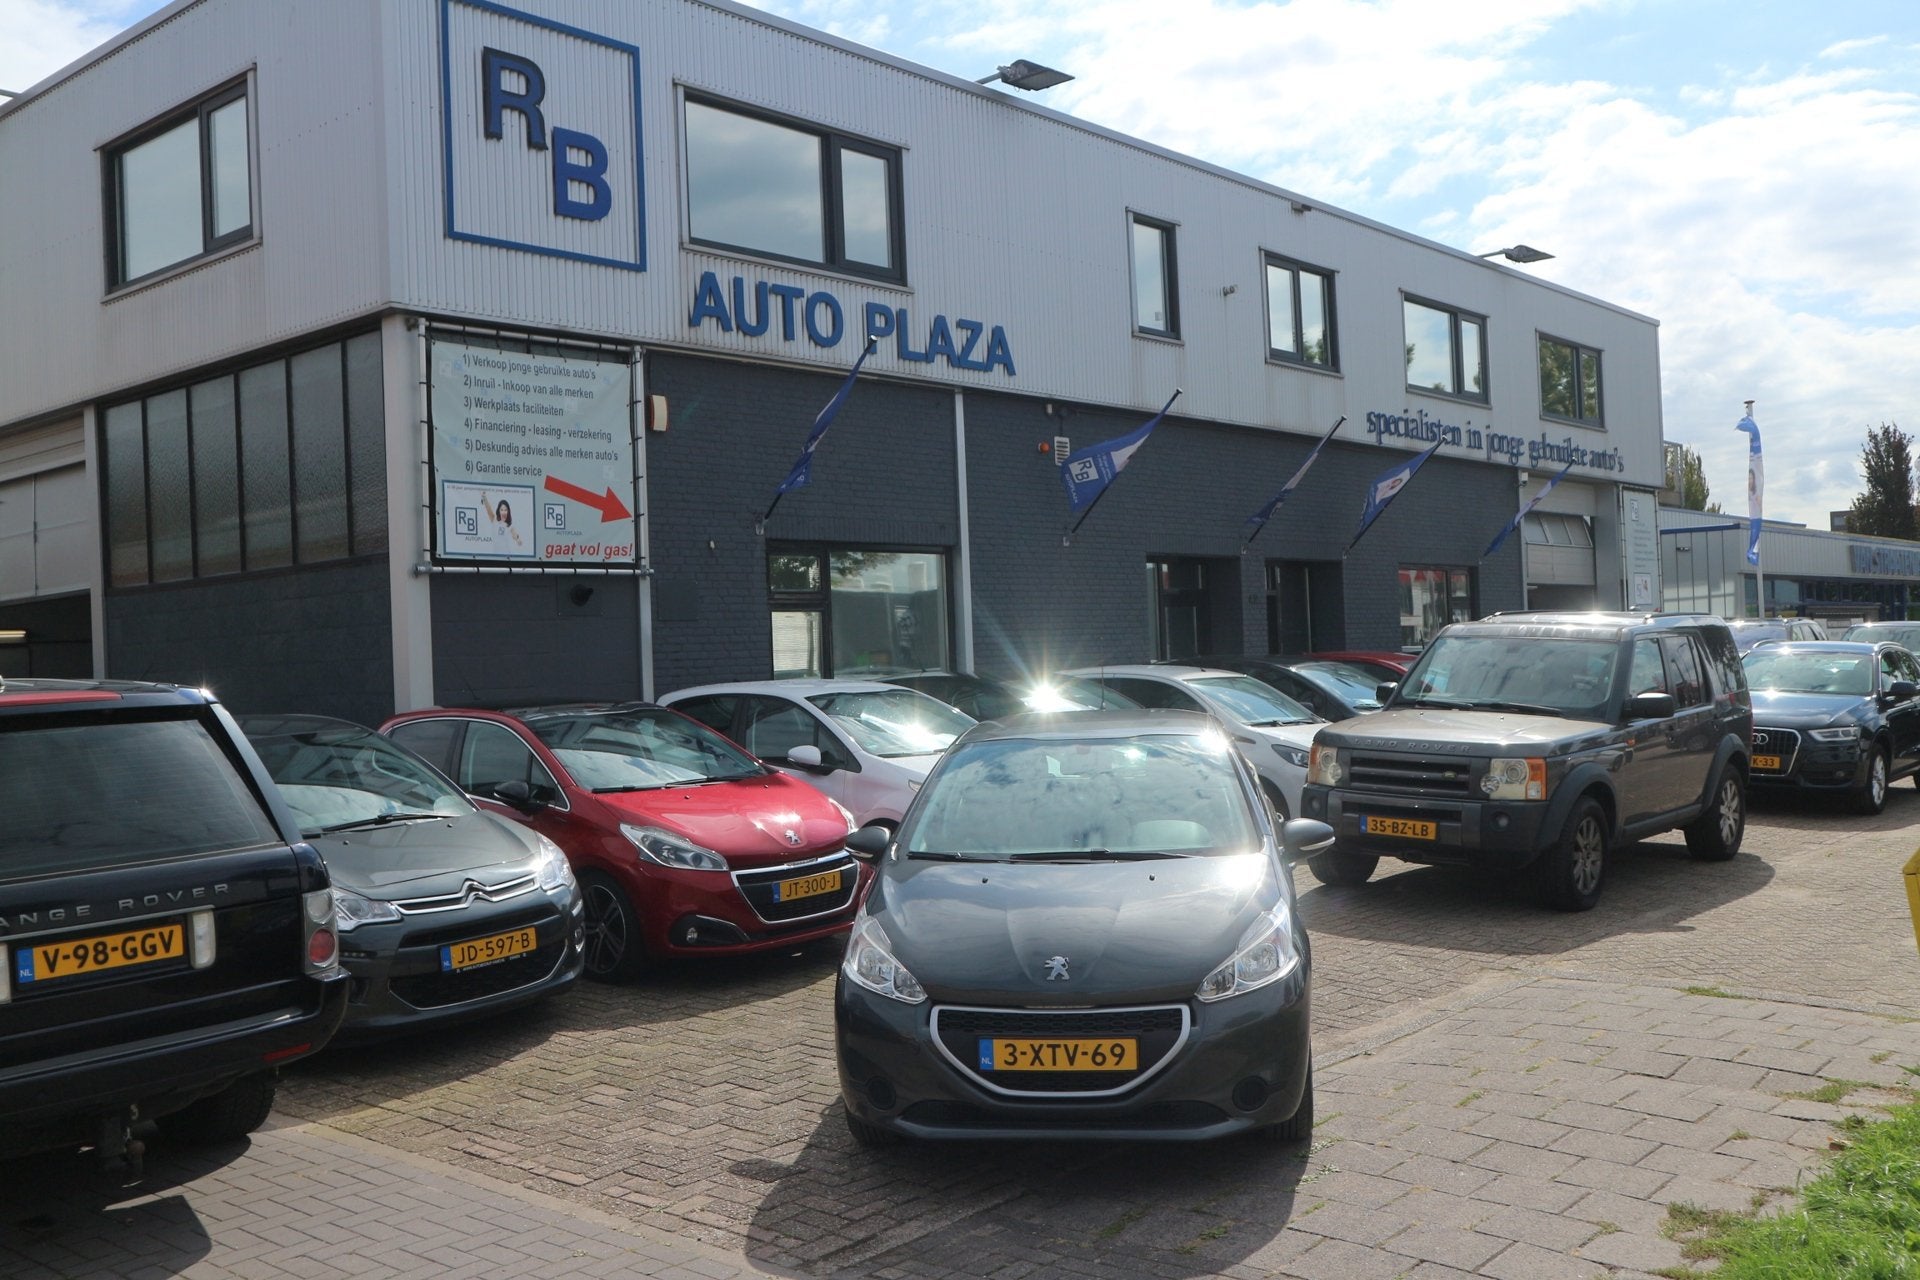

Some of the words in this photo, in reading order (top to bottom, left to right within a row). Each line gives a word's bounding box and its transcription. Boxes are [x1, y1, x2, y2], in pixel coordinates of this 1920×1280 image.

[482, 46, 612, 222] RB
[689, 271, 844, 348] AUTO
[864, 301, 1016, 376] PLAZA
[462, 353, 470, 368] 1)
[472, 355, 507, 372] Verkoop
[508, 360, 532, 375] jonge
[533, 363, 571, 377] gebruikte
[572, 368, 596, 380] auto's
[463, 374, 472, 388] 2)
[474, 375, 496, 389] Inruil
[502, 379, 531, 395] Inkoop
[532, 385, 547, 395] van
[549, 384, 563, 396] alle
[564, 387, 594, 399] merken
[463, 396, 472, 410] 3)
[474, 397, 521, 413] Werkplaats
[522, 402, 564, 417] faciliteiten
[464, 417, 473, 432] 4)
[474, 418, 526, 437] Financiering
[533, 423, 562, 440] leasing
[567, 428, 612, 444] verzekering
[1366, 408, 1462, 445] specialisten
[1466, 420, 1483, 450] in
[1485, 425, 1525, 466] jonge
[1528, 432, 1588, 469] gebruikte
[1588, 447, 1624, 473] auto's
[465, 438, 473, 452] 5)
[475, 439, 520, 457] Deskundig
[521, 444, 548, 457] advies
[549, 445, 563, 457] alle
[565, 447, 594, 460] merken
[595, 450, 618, 461] auto's
[465, 460, 473, 474] 6)
[475, 461, 511, 475] Garantie
[513, 465, 542, 476] service
[458, 511, 475, 532] RB
[547, 507, 563, 526] RB
[545, 543, 577, 558] gaat
[579, 543, 600, 556] vol
[604, 543, 633, 560] gas!
[1354, 738, 1398, 748] LAND
[1408, 742, 1473, 752] ROVER
[1370, 819, 1430, 837] 35-BZ-LB
[118, 884, 229, 911] ROVER
[786, 874, 836, 898] JT-300-J
[42, 929, 175, 974] V-98-GGV
[458, 932, 530, 964] JD-597-B
[19, 968, 33, 978] NL
[981, 1057, 992, 1065] NL
[1003, 1043, 1126, 1067] 3-XTV-69
